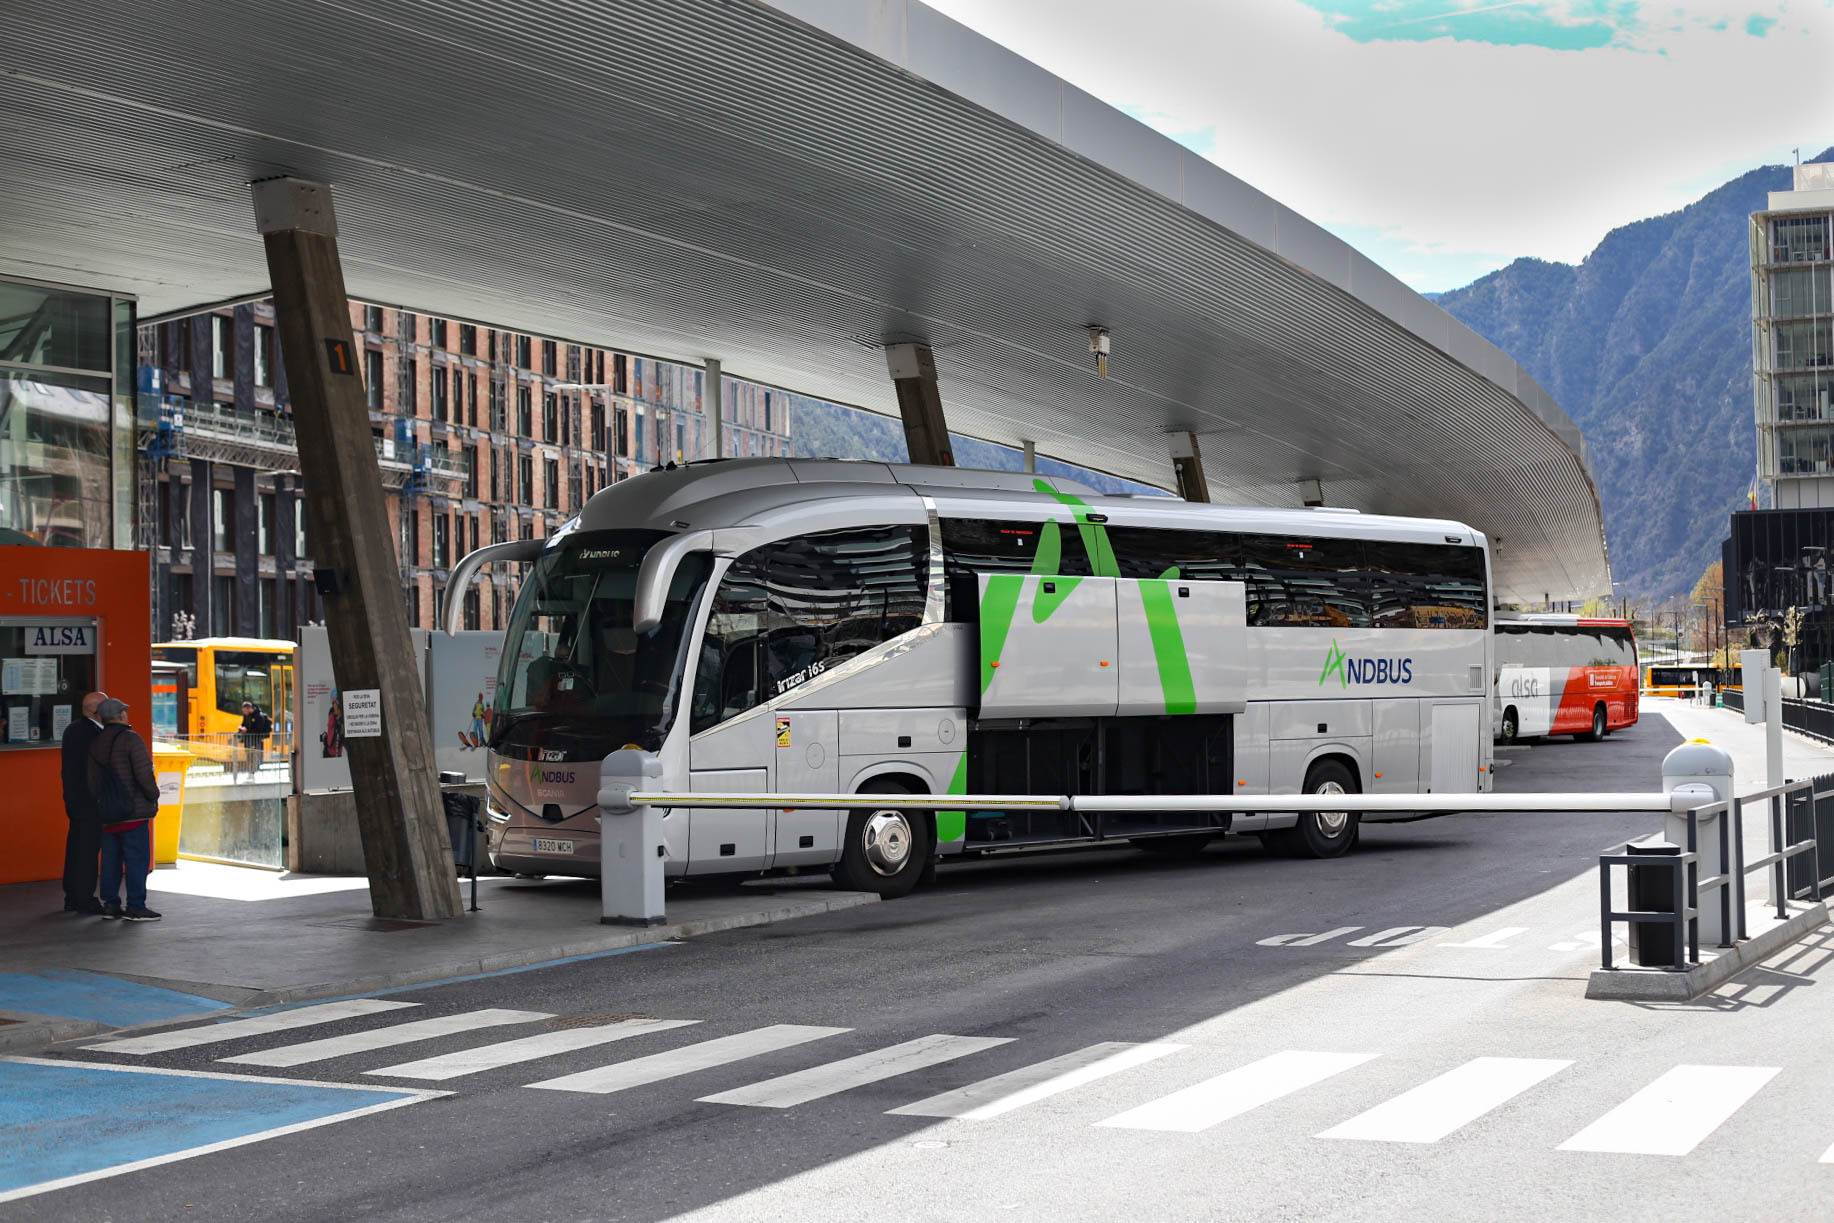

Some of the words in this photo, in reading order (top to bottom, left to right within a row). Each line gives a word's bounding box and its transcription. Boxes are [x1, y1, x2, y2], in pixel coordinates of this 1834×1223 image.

[333, 343, 346, 371] 1
[19, 578, 96, 605] TICKETS
[33, 626, 87, 646] ALSA
[1319, 638, 1412, 689] ANDBUS
[777, 669, 806, 693] irizar
[808, 661, 825, 678] i6s
[1511, 674, 1538, 699] alsa
[348, 701, 376, 710] SEGURETAT
[530, 763, 575, 784] ANDBUS
[536, 788, 565, 798] SCANIA
[538, 840, 556, 851] 8320
